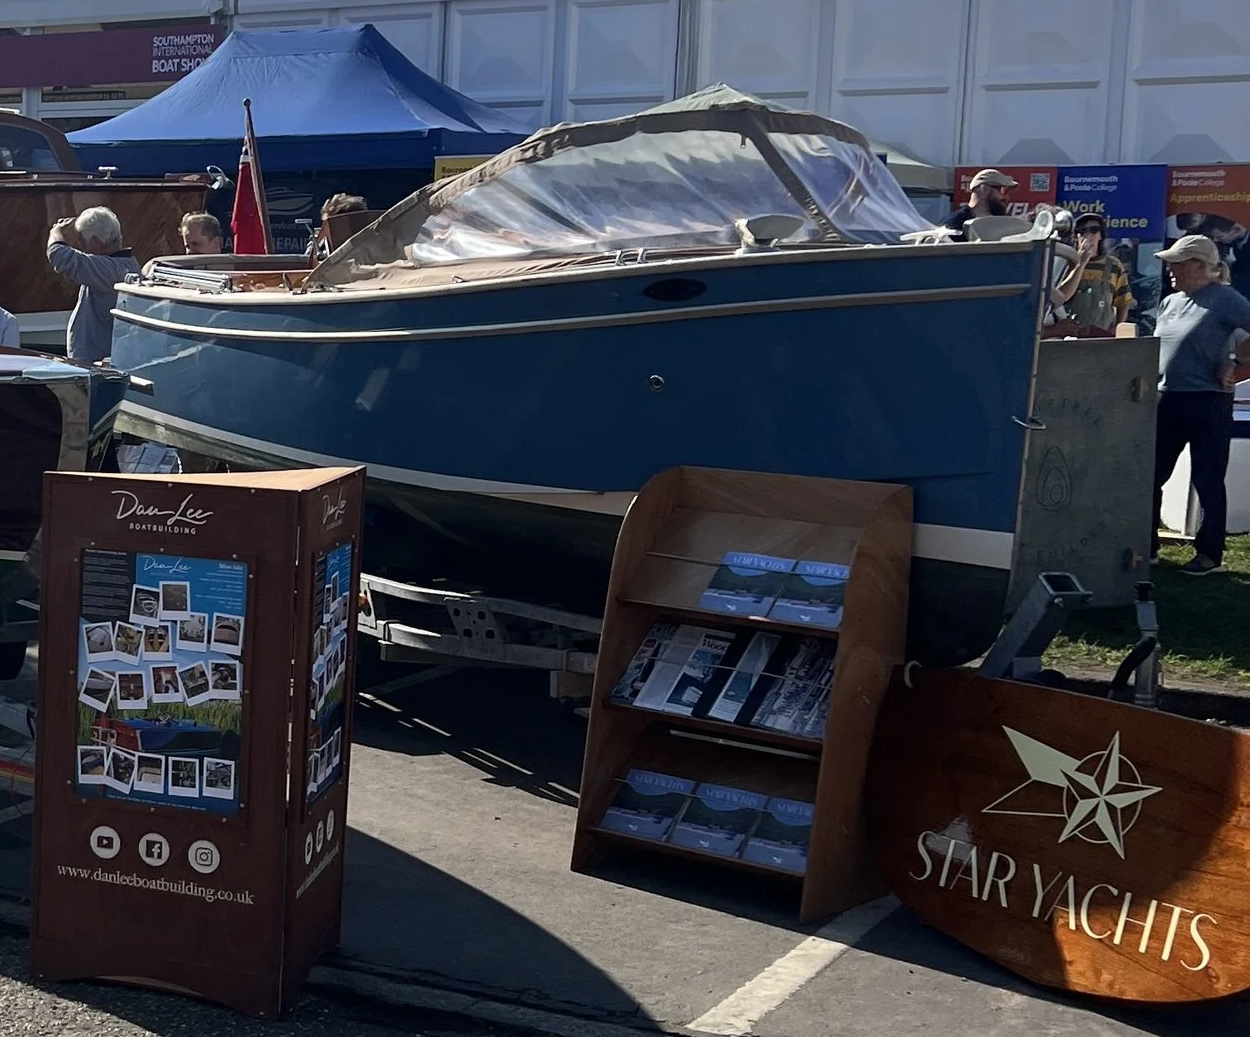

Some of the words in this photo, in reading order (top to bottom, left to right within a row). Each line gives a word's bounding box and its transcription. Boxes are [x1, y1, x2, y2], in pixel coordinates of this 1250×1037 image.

[152, 34, 214, 46] SOUTHAMPTON
[152, 45, 212, 57] INTERNATIONAL
[152, 59, 180, 73] BOAT
[180, 58, 208, 71] SHO
[1064, 175, 1118, 184] Bournemouth
[1172, 170, 1226, 179] Bournemouth
[1063, 201, 1105, 213] Work
[1104, 215, 1148, 228] ience
[273, 237, 309, 250] EPAI
[111, 490, 175, 519] Dan
[167, 493, 214, 525] Lee
[129, 523, 197, 535] BOATBUILDING
[169, 557, 192, 574] Lee
[57, 865, 255, 905] www.danleeboatbuilding.co.uk
[909, 830, 1017, 908] STAR
[1032, 863, 1218, 971] YACHTS
